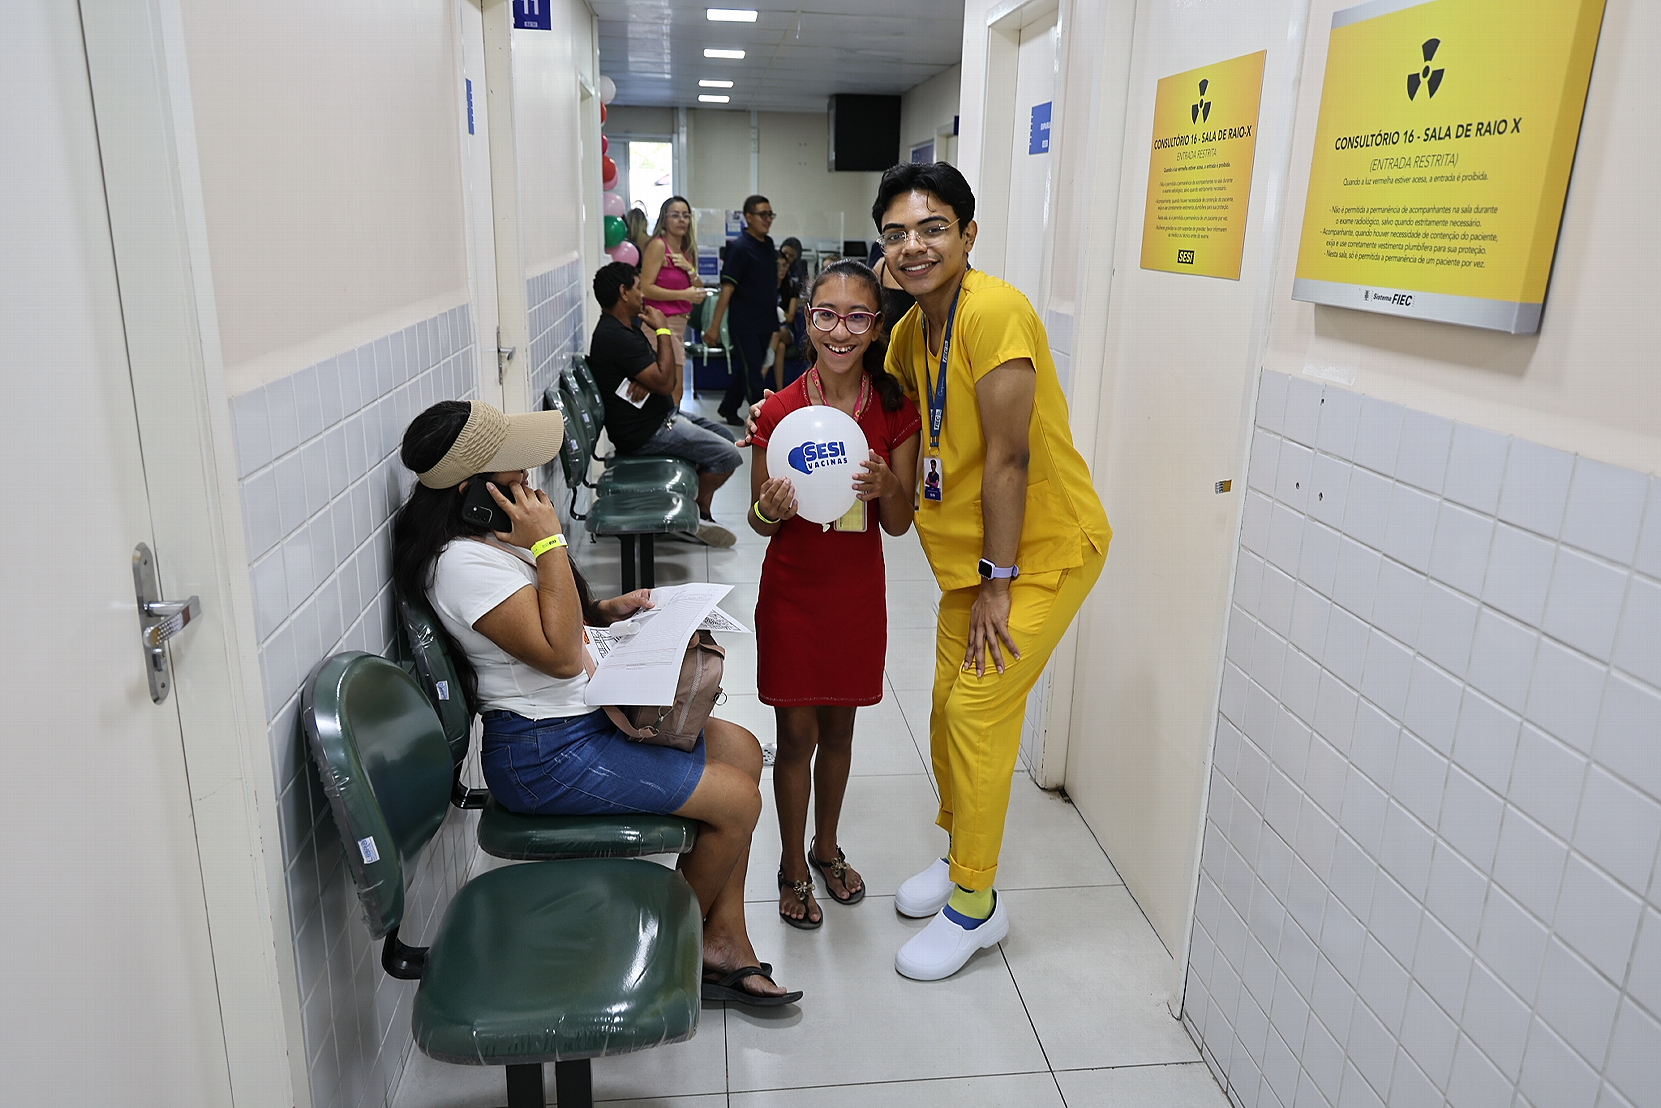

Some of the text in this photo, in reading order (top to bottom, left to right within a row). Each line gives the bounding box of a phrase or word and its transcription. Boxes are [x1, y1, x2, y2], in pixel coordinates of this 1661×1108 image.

[1154, 135, 1189, 149] CONSULTÓRIO
[1191, 134, 1197, 144] 16
[1201, 131, 1217, 144] SALA
[1217, 129, 1228, 141] DE
[1228, 125, 1252, 138] RAIO-X
[1335, 130, 1400, 150] CONSULTÓRIO
[1403, 129, 1415, 144] 16
[1422, 125, 1452, 142] SALA
[1455, 123, 1473, 139] DE
[1475, 119, 1508, 137] RAIO
[1510, 117, 1522, 134] X
[1369, 153, 1459, 173] (ENTRADA RESTRITA)
[1343, 177, 1361, 186] Quando
[1372, 176, 1394, 185] vermelha
[1394, 175, 1412, 184] estiver
[1412, 174, 1428, 184] acesa,
[1433, 173, 1456, 183] entrada
[1461, 171, 1489, 183] proibida.
[1332, 206, 1341, 214] Não
[1345, 206, 1366, 215] permitida
[1370, 205, 1401, 215] permanência
[1401, 205, 1409, 214] de
[1409, 205, 1452, 215] acompanhantes
[1452, 206, 1460, 214] na
[1460, 205, 1473, 214] sala
[1473, 205, 1498, 214] durante
[1354, 217, 1380, 228] radiológico,
[1381, 218, 1394, 226] salvo
[1394, 217, 1414, 228] quando
[1414, 218, 1449, 227] estritamente
[1449, 218, 1482, 227] necessário.
[1323, 228, 1354, 236] Acompanhante,
[1355, 228, 1373, 238] quando
[1373, 228, 1390, 238] houver
[1390, 229, 1422, 239] necessidade
[1422, 230, 1430, 239] de
[1430, 231, 1460, 242] contenção
[1460, 231, 1470, 241] do
[1470, 232, 1499, 243] paciente,
[1178, 250, 1194, 263] SESI
[1347, 241, 1378, 249] corretamente
[1378, 242, 1404, 251] vestimenta
[1404, 242, 1433, 252] plumbífera
[1433, 244, 1447, 254] para
[1447, 245, 1458, 253] sua
[1458, 245, 1487, 257] proteção.
[1326, 249, 1339, 258] Nesta
[1359, 251, 1381, 261] permitida
[1385, 254, 1417, 264] permanência
[1417, 255, 1426, 264] de
[1436, 257, 1461, 267] paciente
[1461, 259, 1473, 269] por
[1473, 260, 1486, 268] vez.
[1391, 293, 1413, 306] FIEC
[804, 441, 846, 462] SESI
[807, 457, 848, 470] VACINAS
